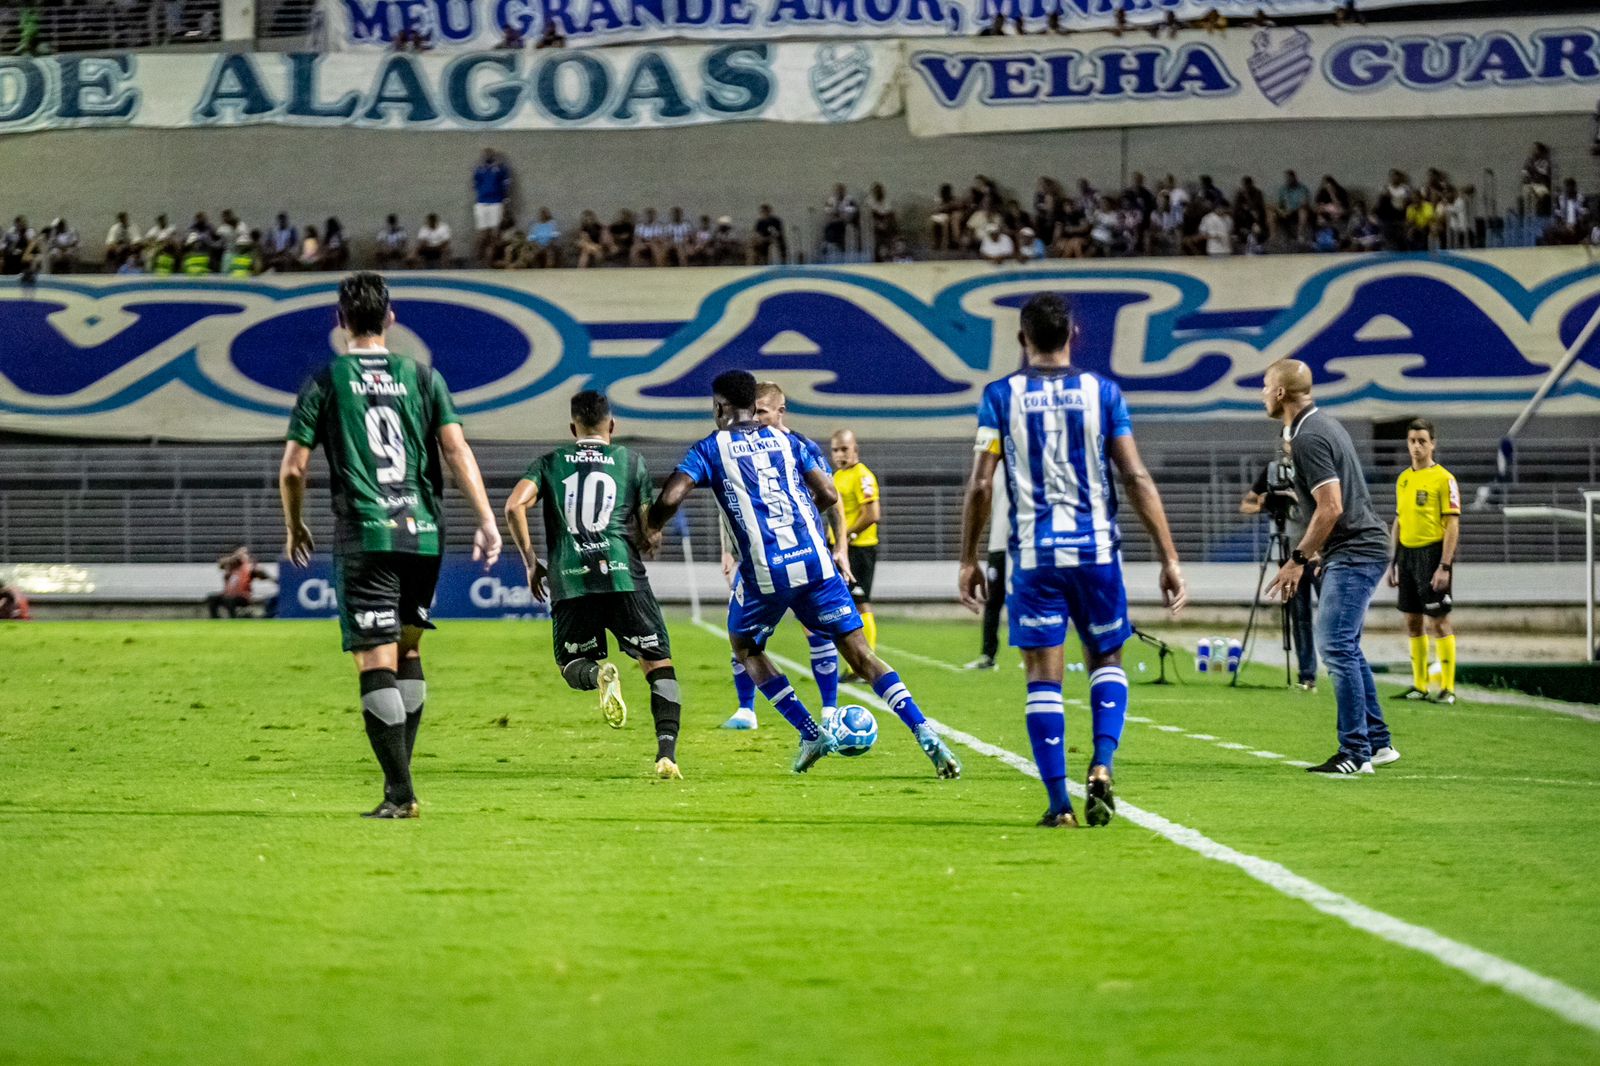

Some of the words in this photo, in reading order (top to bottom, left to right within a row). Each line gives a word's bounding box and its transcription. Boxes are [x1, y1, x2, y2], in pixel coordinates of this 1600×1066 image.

[200, 43, 773, 121] ALAGOAS
[913, 47, 1239, 106] VELHA
[349, 381, 408, 396] TUCHAUA
[365, 405, 406, 485] 9
[564, 454, 616, 466] TUCHAUA
[561, 471, 617, 534] 10
